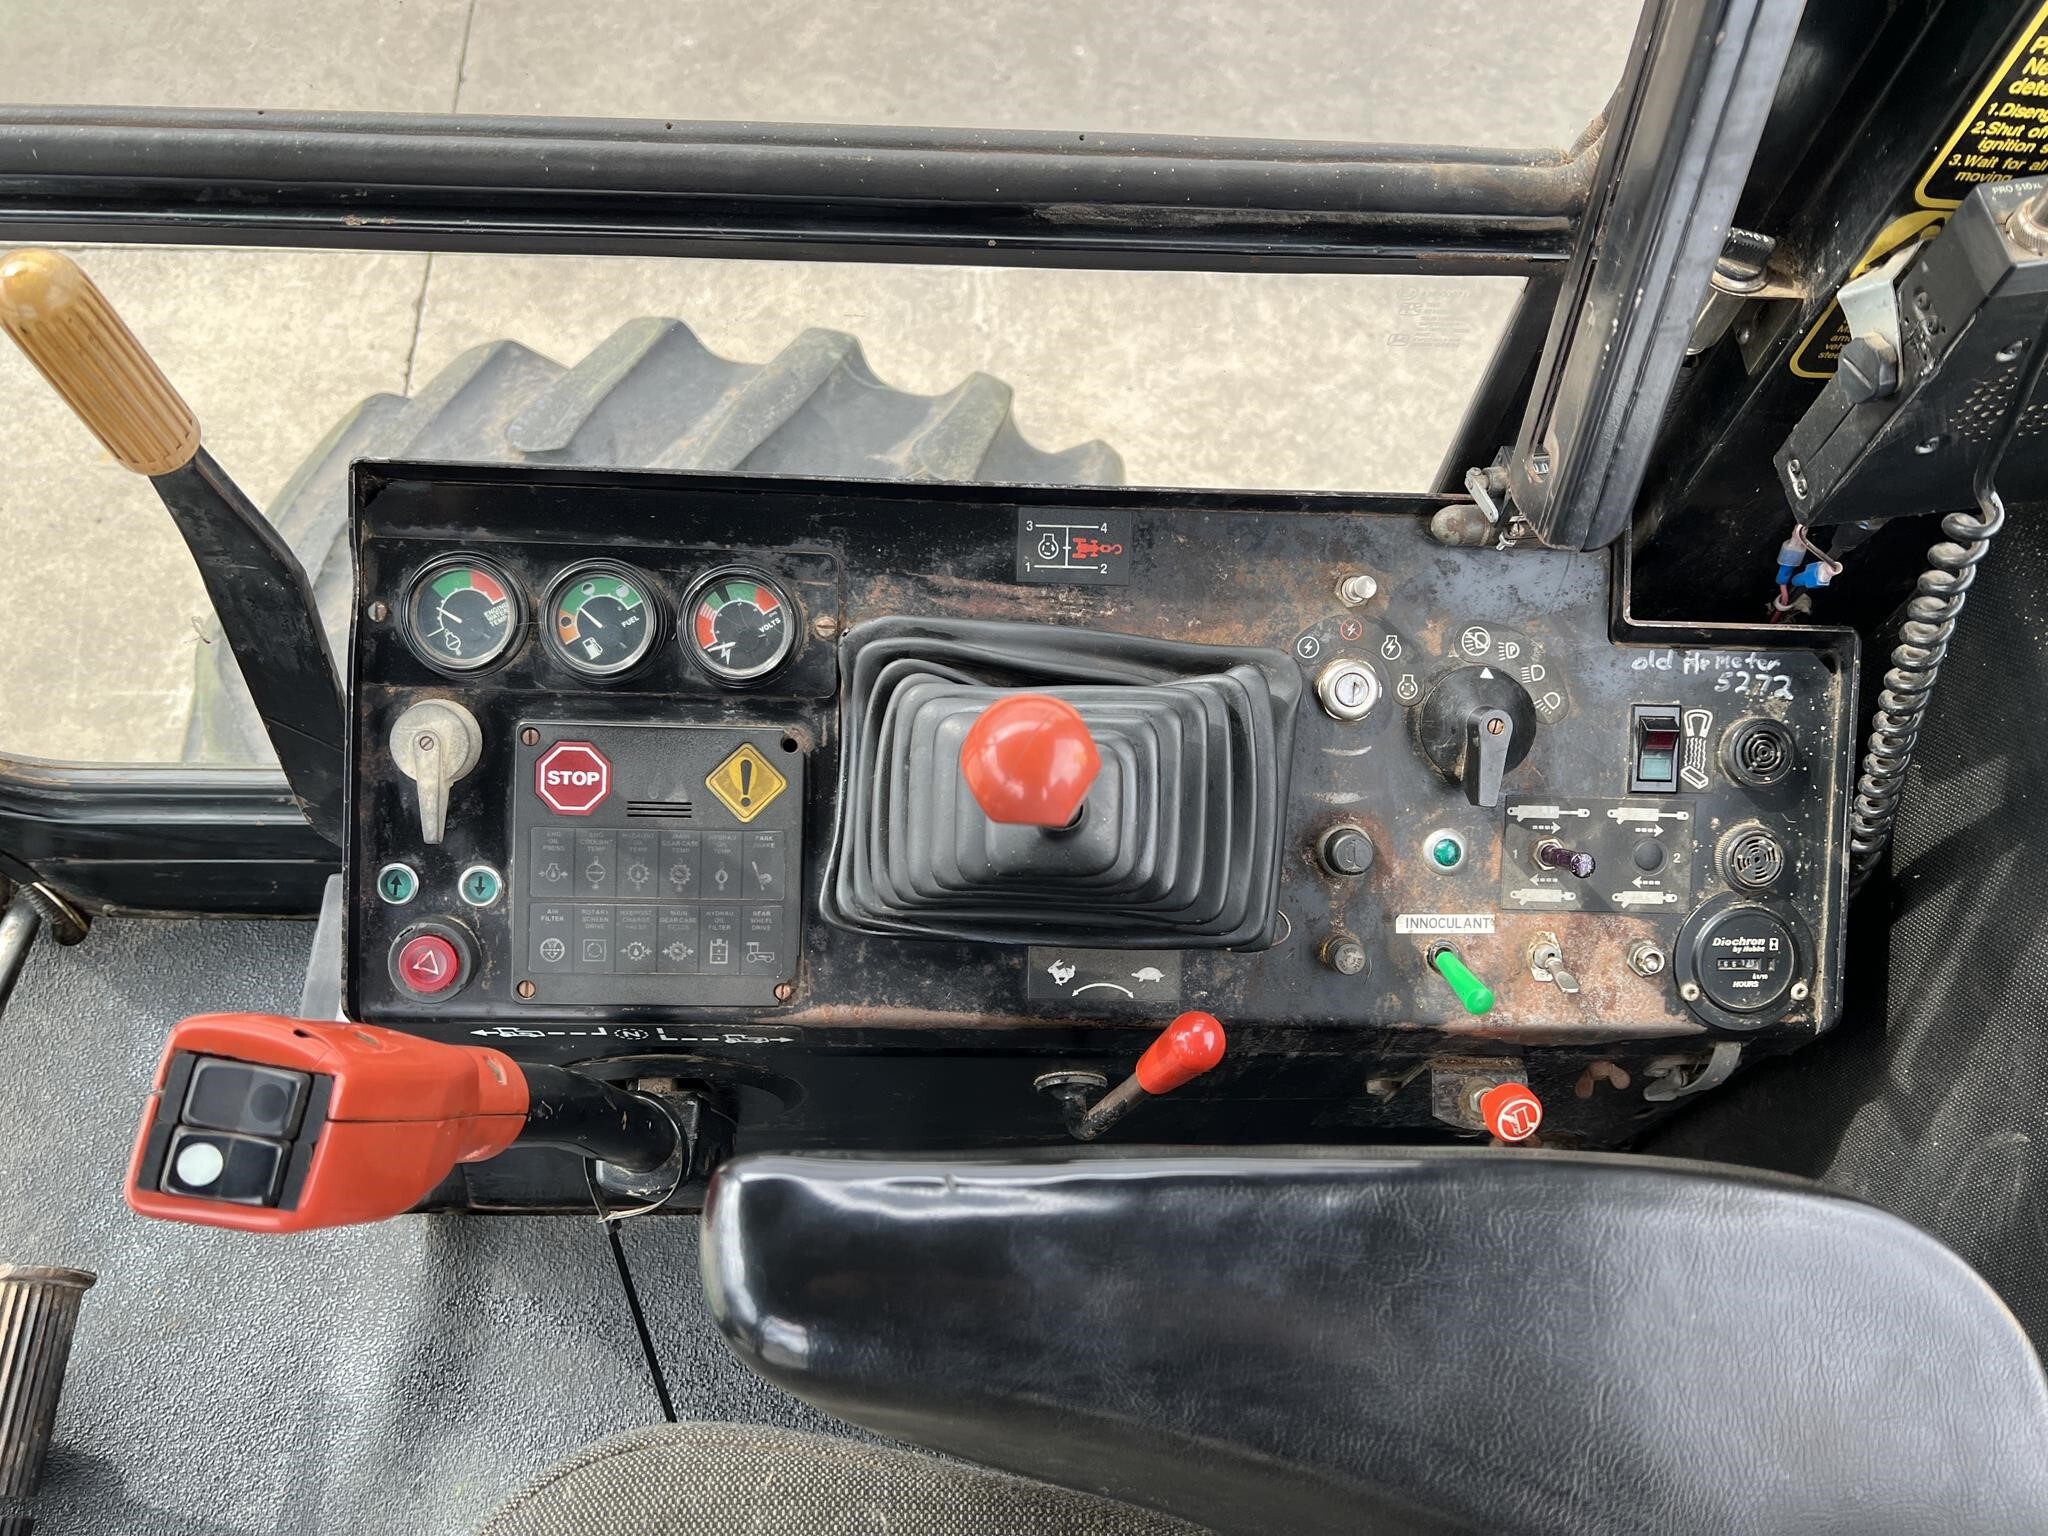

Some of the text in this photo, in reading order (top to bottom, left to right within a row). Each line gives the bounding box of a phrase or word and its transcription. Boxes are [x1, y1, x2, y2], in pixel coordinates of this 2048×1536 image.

[1977, 136, 2037, 153] ignition
[2002, 157, 2027, 170] for
[1992, 184, 2014, 195] PRO
[1025, 520, 1108, 534] 3 4
[1024, 561, 1108, 575] 1 2
[621, 615, 640, 628] FUEL
[758, 617, 782, 633] VOLTS
[1631, 650, 1674, 671] old
[1714, 671, 1794, 700] 5272
[547, 770, 600, 786] STOP
[1512, 848, 1681, 863] 1 2
[1405, 917, 1491, 929] INNOCULANT
[1712, 936, 1766, 947] Diochron
[1732, 980, 1760, 988] HOURS
